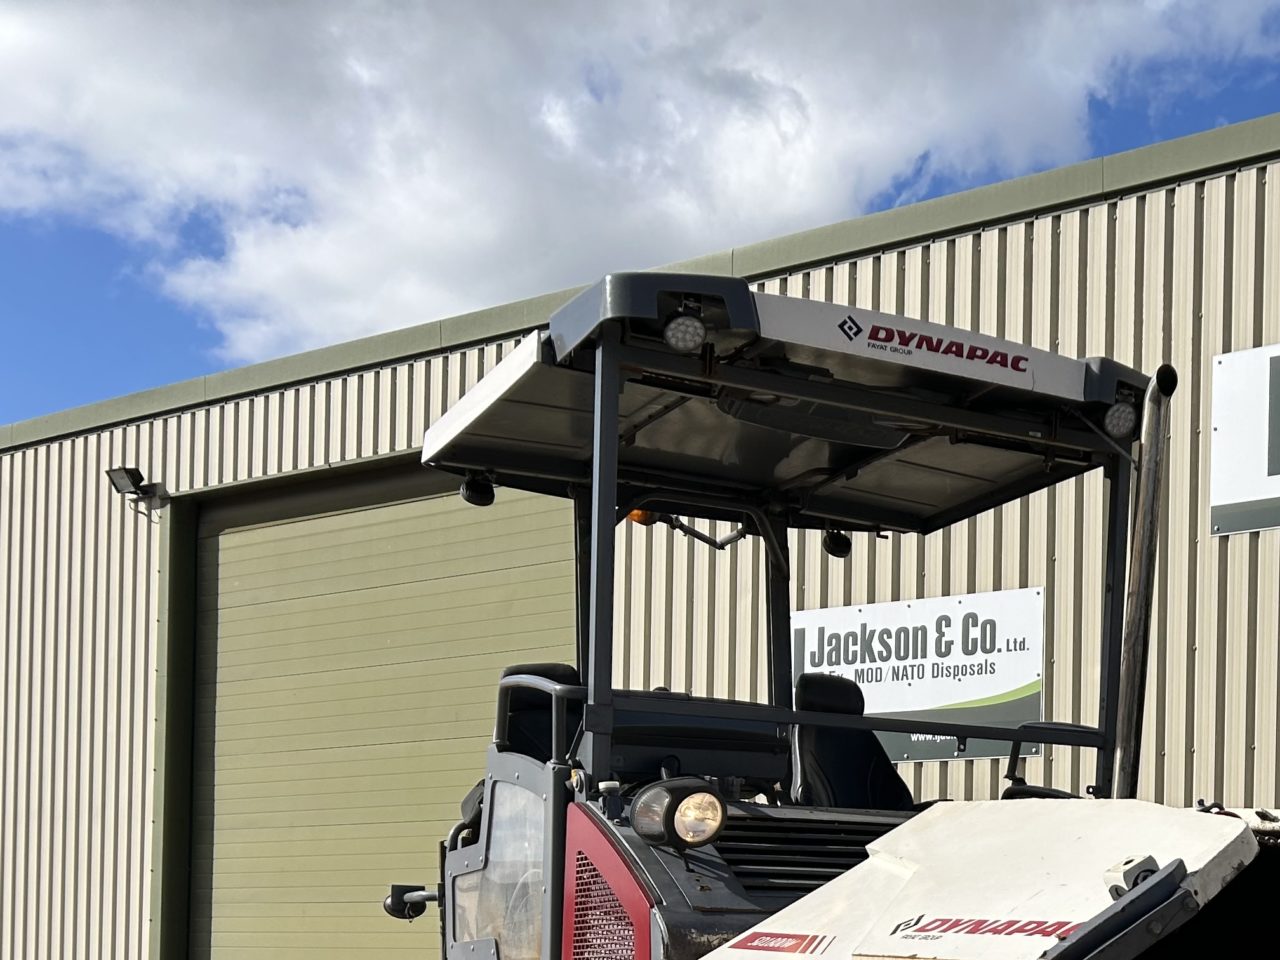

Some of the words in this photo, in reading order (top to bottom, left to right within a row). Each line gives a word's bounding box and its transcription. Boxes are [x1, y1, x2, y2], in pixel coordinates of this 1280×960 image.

[867, 342, 888, 351] FAYAT
[889, 346, 913, 356] GROUP
[868, 324, 1029, 373] DYNAPAC
[934, 614, 955, 659] &
[961, 611, 1002, 656] Co.
[1005, 636, 1030, 653] Ltd.
[854, 663, 925, 684] MOD/NATO
[931, 658, 996, 680] Disposals
